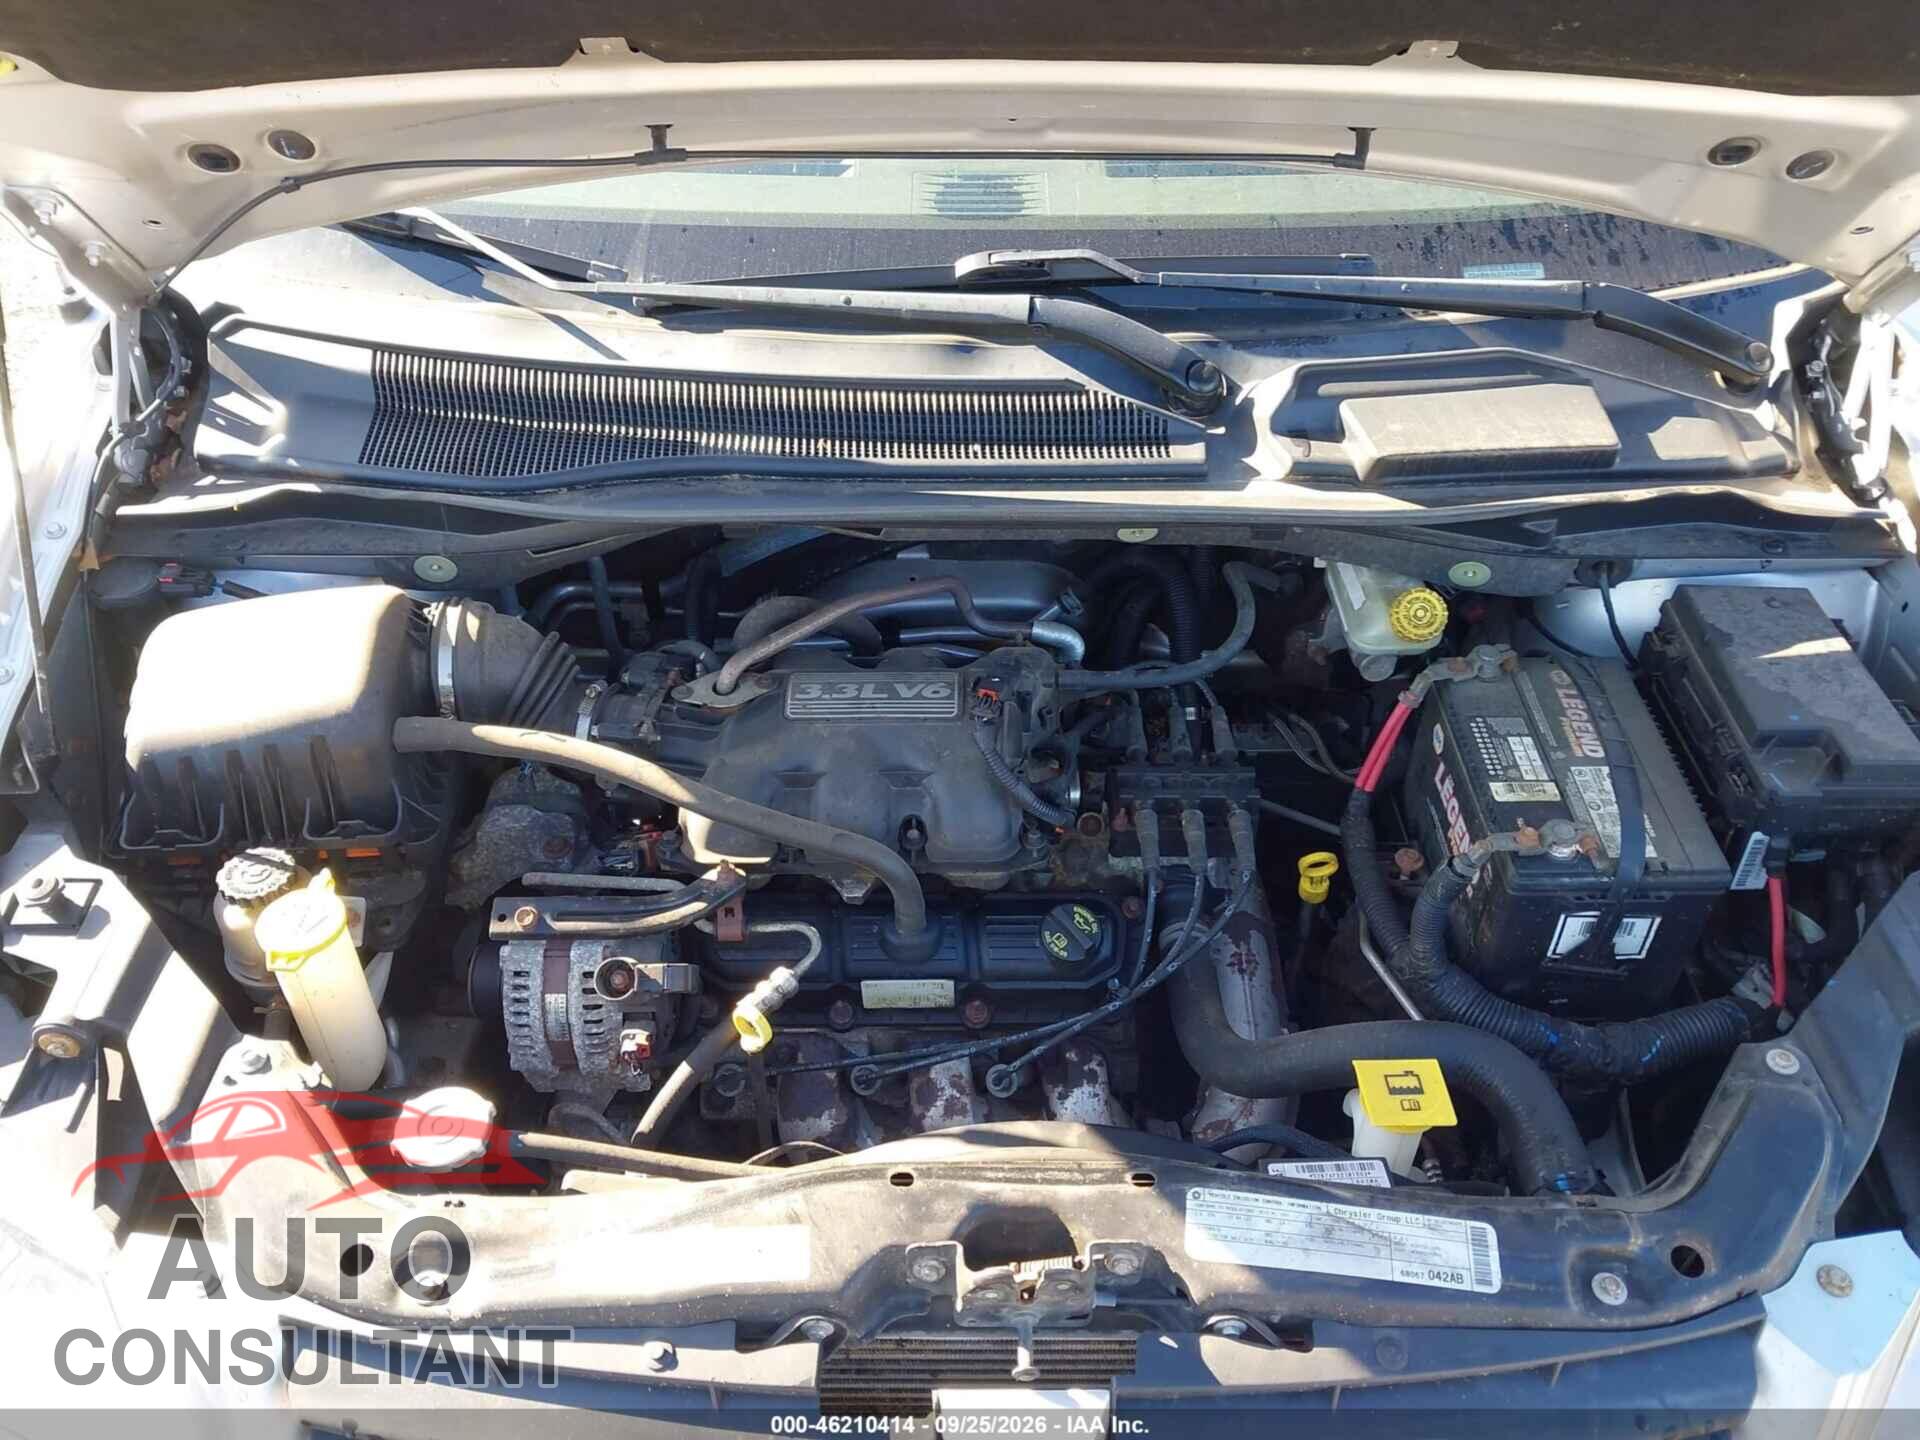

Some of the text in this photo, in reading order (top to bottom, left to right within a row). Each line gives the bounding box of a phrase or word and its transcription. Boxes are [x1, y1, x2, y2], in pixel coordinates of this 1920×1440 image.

[795, 682, 953, 700] 3.3L V6
[1556, 687, 1605, 757] LEGEND
[1334, 1207, 1372, 1219] Chrysler
[1377, 1212, 1402, 1224] Group
[1428, 1269, 1464, 1285] 042AB
